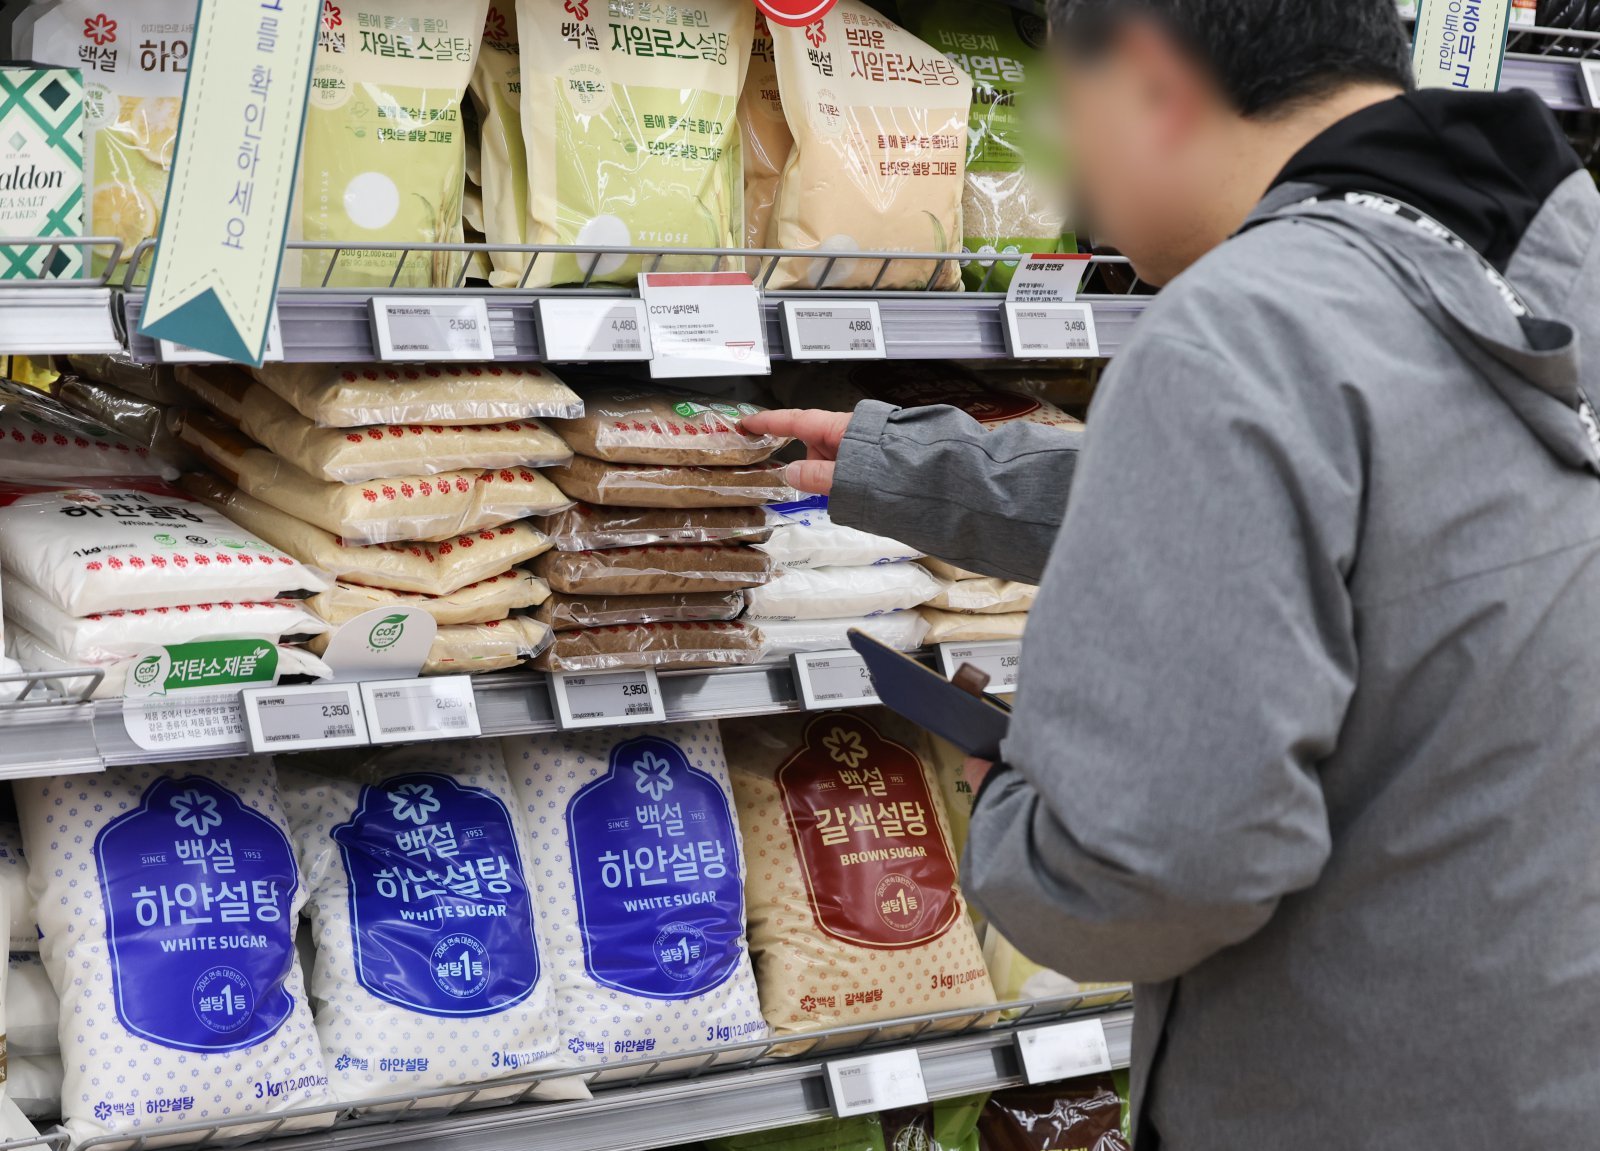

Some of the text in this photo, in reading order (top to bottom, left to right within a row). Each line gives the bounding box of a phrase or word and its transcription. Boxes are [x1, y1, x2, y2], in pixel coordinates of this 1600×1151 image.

[359, 30, 472, 63] 자일로스설탕
[608, 24, 730, 66] 자일로스설탕
[846, 28, 886, 50] 브라운
[938, 30, 999, 52] 비정제
[807, 48, 834, 77] 백설
[851, 51, 960, 86] 자일로스설탕
[312, 78, 346, 90] 자일로스
[408, 128, 428, 142] 설탕
[428, 131, 453, 145] 그대로
[222, 64, 275, 250] 확인하세요
[0, 165, 64, 190] aldon
[911, 161, 931, 176] 설탕
[931, 161, 958, 176] 그대로
[638, 229, 690, 243] XYLOSE
[449, 319, 477, 332] 2,580
[611, 320, 638, 333] 4,480
[849, 320, 872, 332] 4,680
[1064, 321, 1087, 332] 3,490
[169, 655, 258, 682] 저탄소제품
[622, 683, 648, 697] 2,950
[322, 704, 350, 718] 2,350
[816, 781, 837, 791] SINCE
[838, 766, 888, 798] 백설
[607, 820, 630, 830] SINCE
[635, 801, 685, 838] 백설
[690, 811, 706, 821] 1953
[813, 801, 928, 846] 갈색설탕
[395, 821, 460, 862] 백설
[465, 829, 484, 838] 1953
[141, 854, 168, 865] SINCE
[174, 838, 236, 875] 백설
[243, 850, 262, 860] 1953
[597, 838, 728, 888] 하얀설탕
[839, 845, 928, 867] BROWN SUGAR
[131, 879, 283, 927] 하얀설탕
[623, 890, 717, 914] WHITE SUGAR
[399, 904, 507, 922] WHITE SUGAR
[160, 934, 268, 953] WHITE SUGAR
[816, 988, 884, 1008] 백설 갈색설탕
[584, 1038, 657, 1055] 백설 하얀설탕
[351, 1054, 430, 1073] 백설 하얀설탕
[112, 1096, 195, 1116] 백설 하얀설탕
